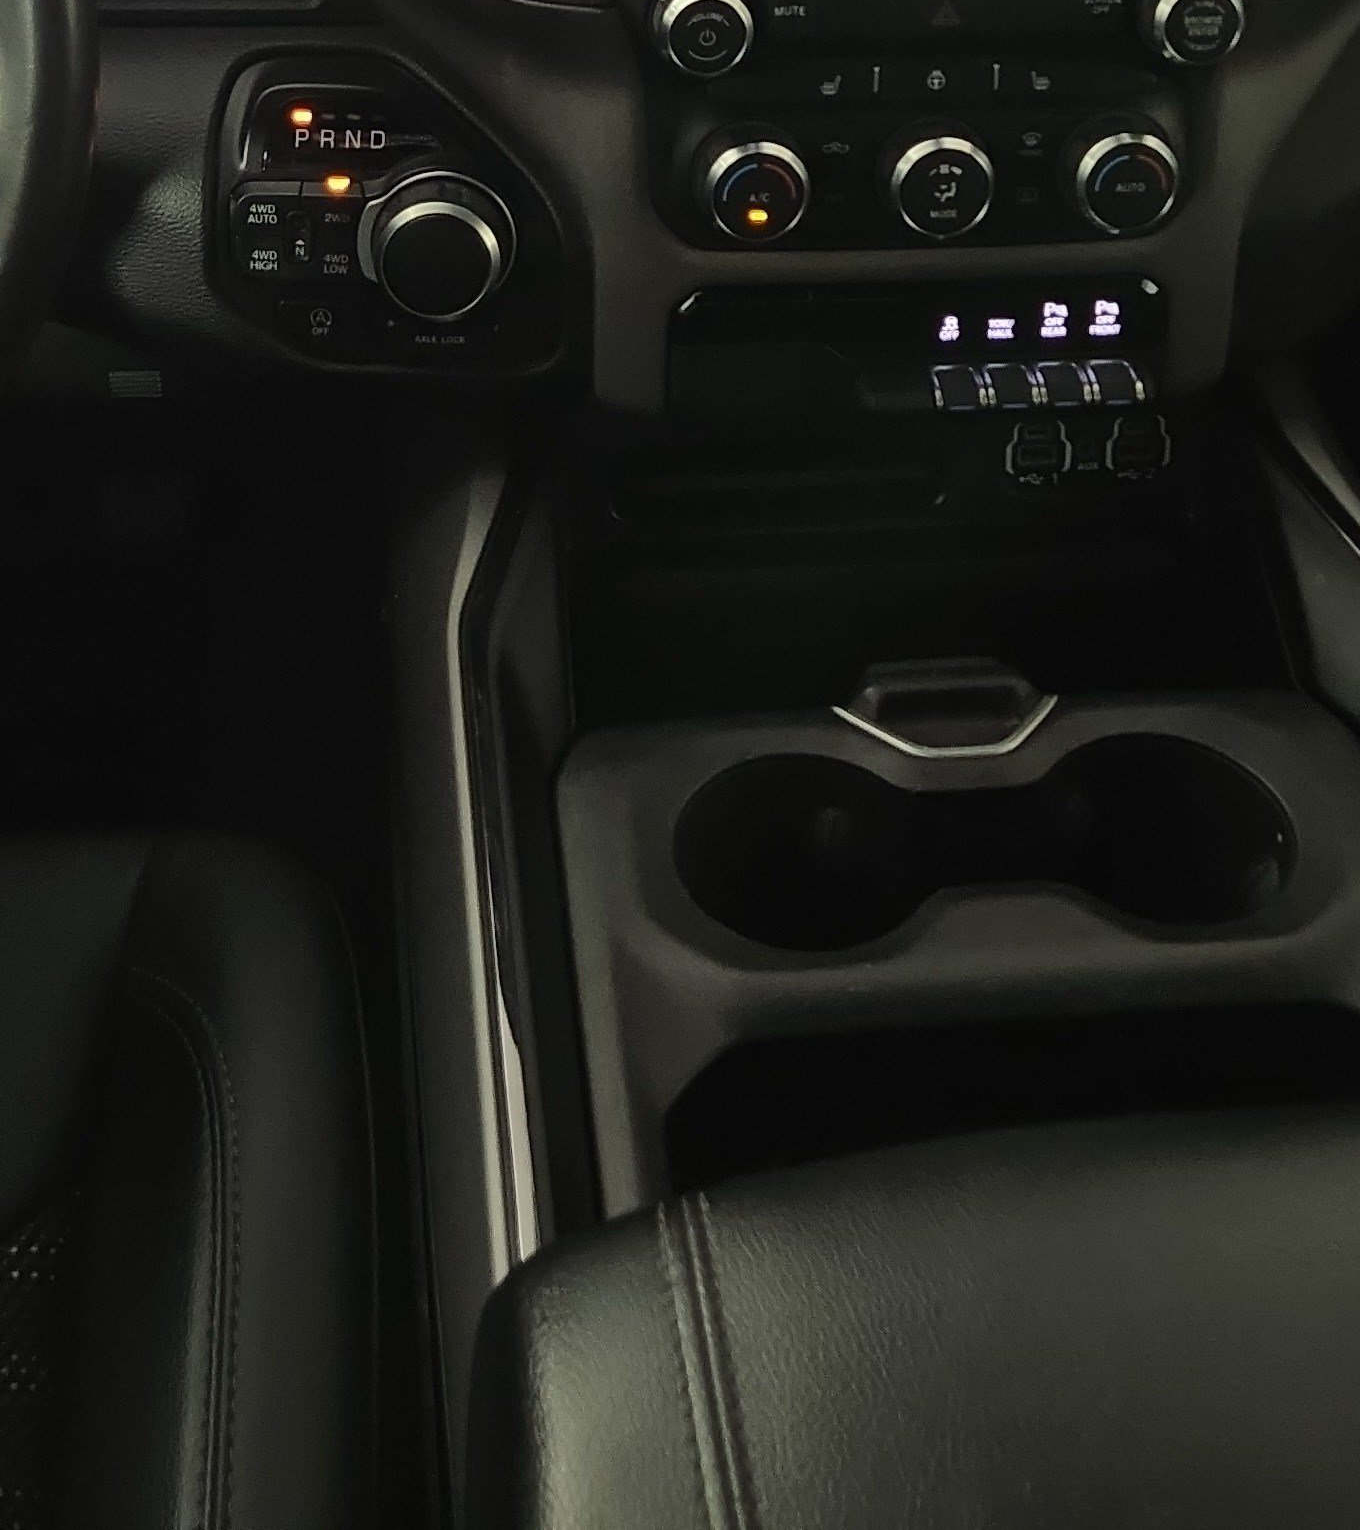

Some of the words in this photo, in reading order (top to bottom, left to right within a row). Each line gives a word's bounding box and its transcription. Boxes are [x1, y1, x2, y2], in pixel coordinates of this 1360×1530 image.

[773, 5, 807, 17] MUTE
[294, 128, 310, 149] P
[320, 129, 336, 149] R
[345, 129, 362, 149] N
[370, 129, 386, 150] D
[1115, 182, 1146, 193] AUTO
[249, 204, 276, 214] 4WD
[247, 213, 278, 225] AUTO
[251, 250, 278, 261] 4WD
[294, 245, 306, 257] N
[323, 254, 349, 264] 4WD
[249, 260, 278, 271] HIGH
[323, 263, 349, 274] LOW
